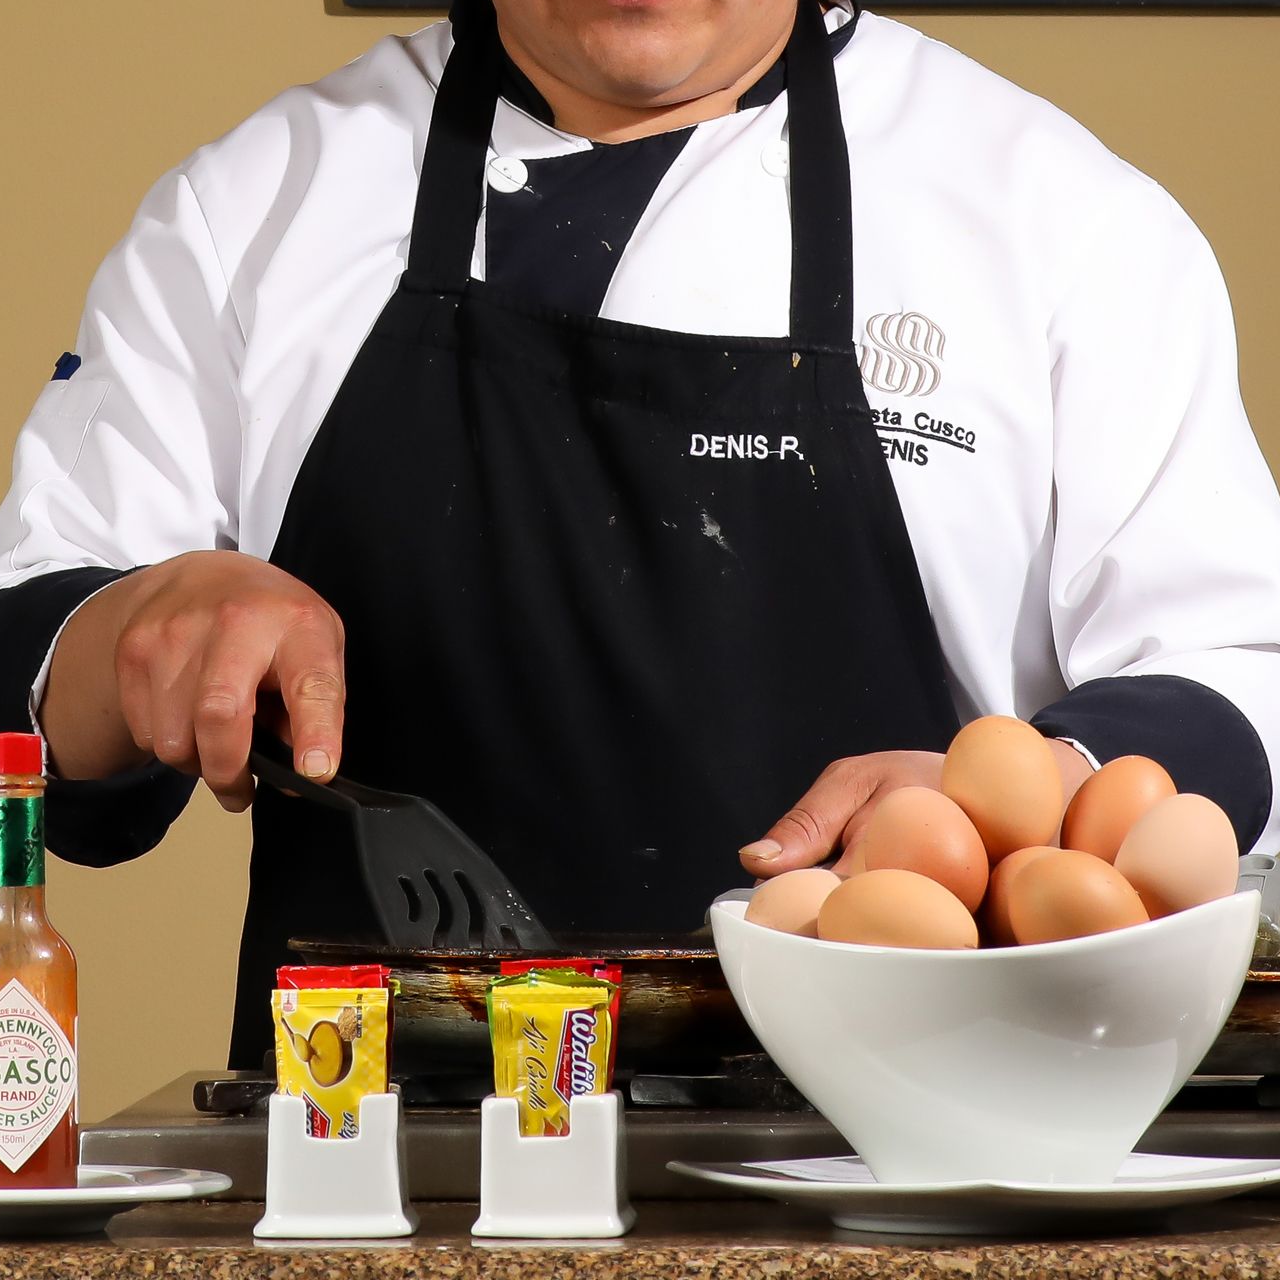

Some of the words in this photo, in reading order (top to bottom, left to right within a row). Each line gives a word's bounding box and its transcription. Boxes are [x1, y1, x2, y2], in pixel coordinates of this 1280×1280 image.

[870, 408, 902, 426] sta
[914, 412, 976, 446] Cusco
[690, 433, 769, 460] DENIS
[880, 436, 928, 467] ENIS
[13, 1038, 36, 1053] ISLAND
[571, 1011, 597, 1095] Walib
[525, 1056, 548, 1110] Criollo
[19, 1085, 59, 1126] SAUCE
[0, 1134, 26, 1144] 150ml
[338, 1112, 359, 1139] taza
